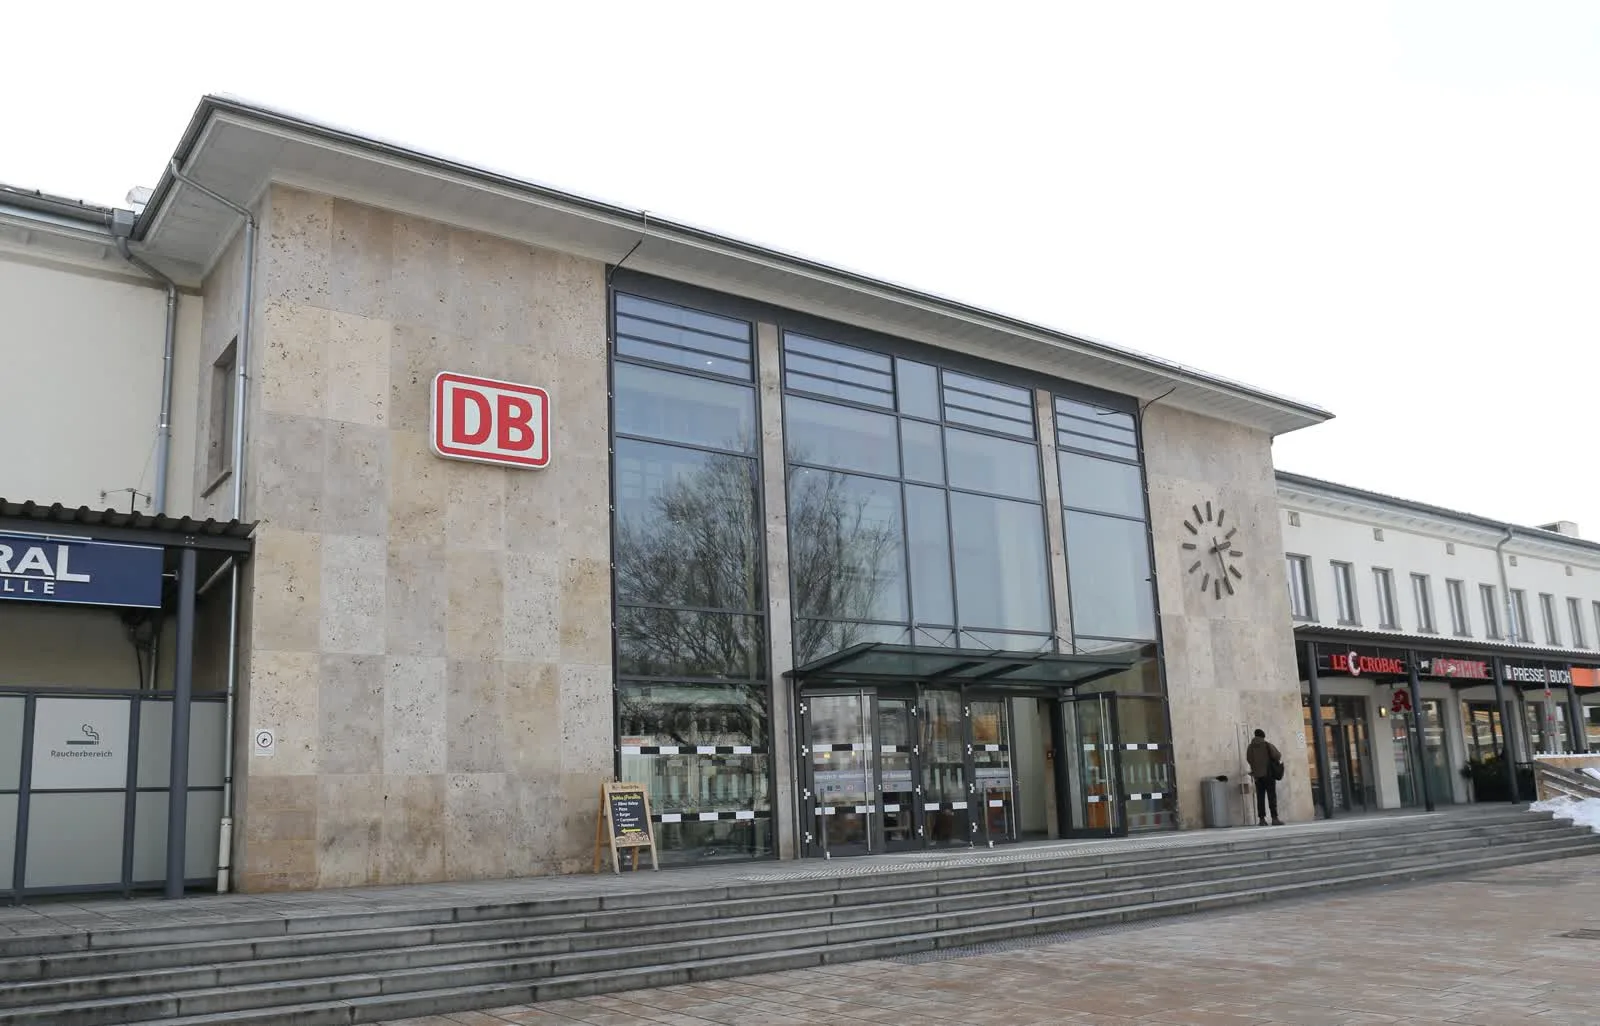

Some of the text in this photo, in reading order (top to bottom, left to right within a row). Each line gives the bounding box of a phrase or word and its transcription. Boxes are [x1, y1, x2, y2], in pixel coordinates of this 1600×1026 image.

[452, 387, 535, 451] DB
[3, 579, 55, 594] LLE
[1331, 654, 1348, 671] LE
[1512, 667, 1571, 683] PRESSE BUCH
[50, 750, 113, 758] Raucherbereich
